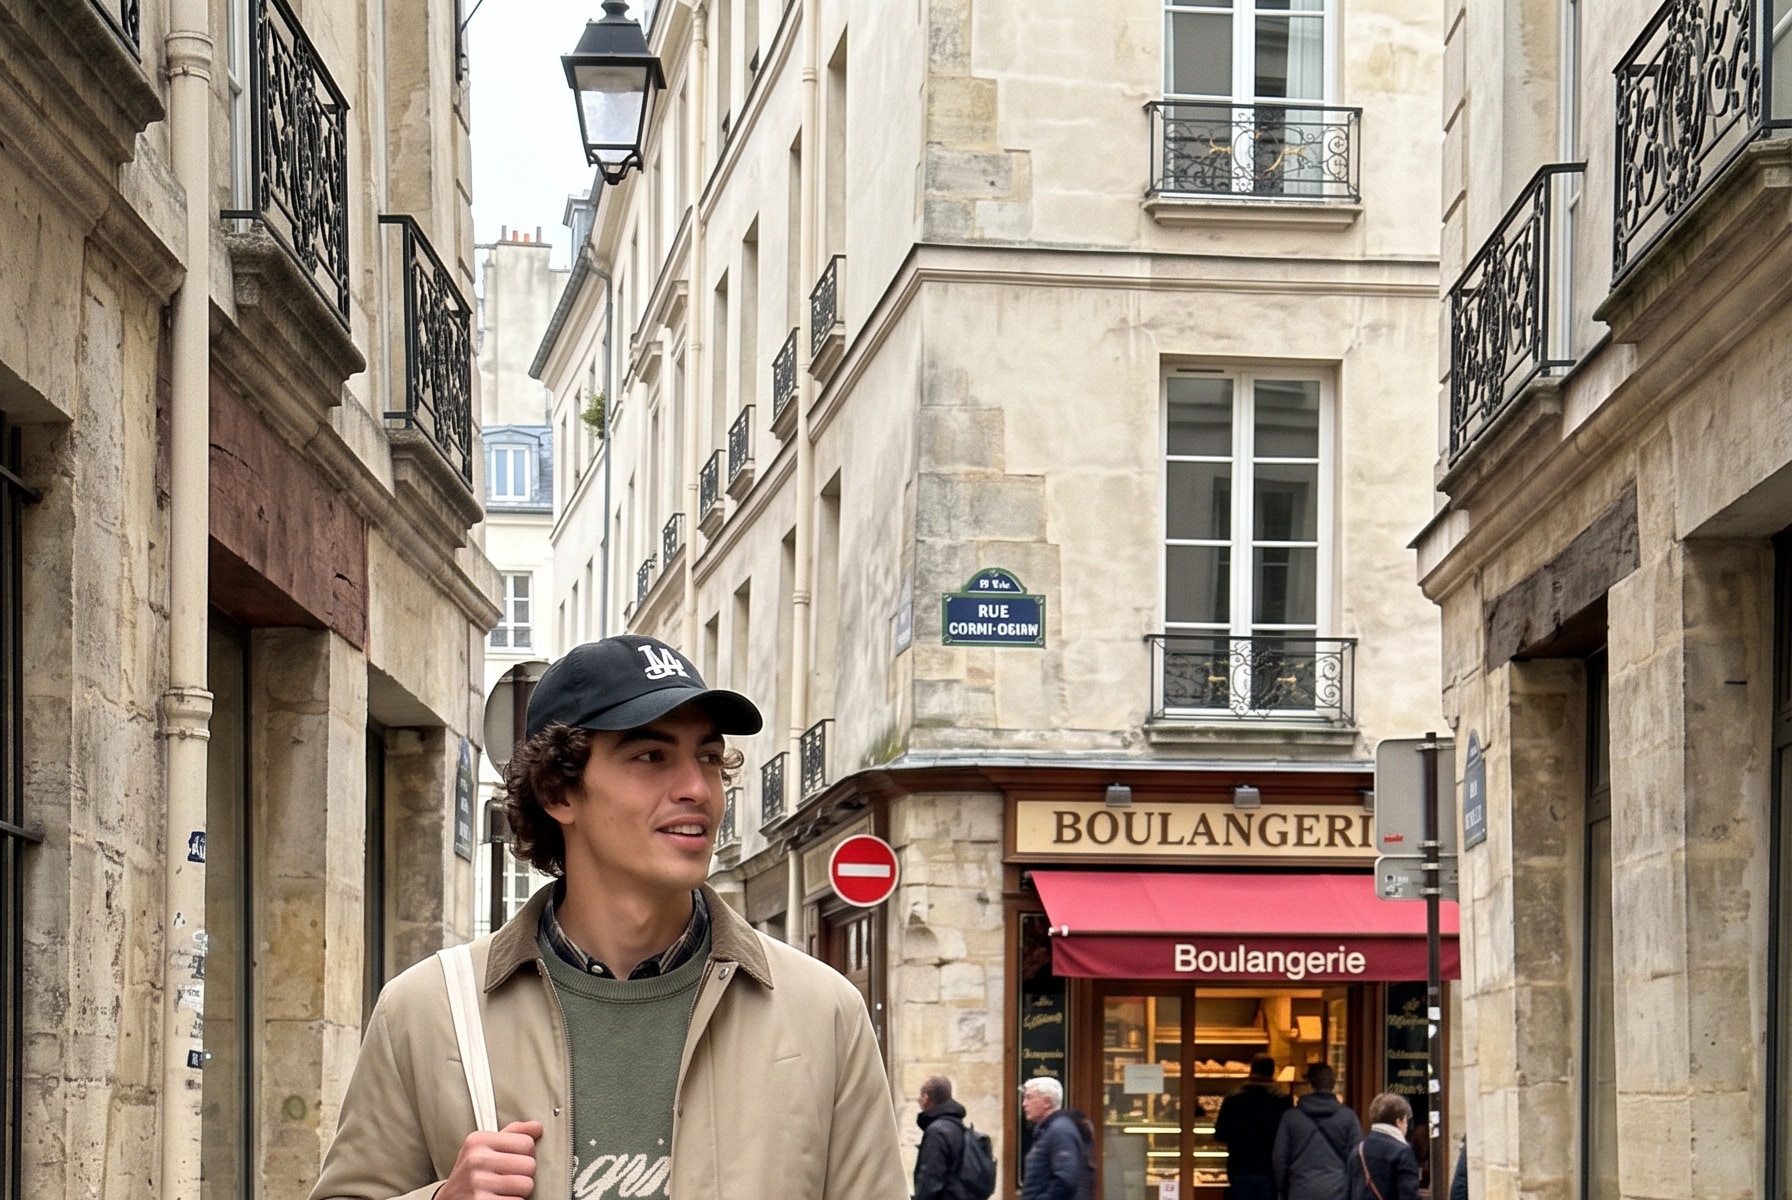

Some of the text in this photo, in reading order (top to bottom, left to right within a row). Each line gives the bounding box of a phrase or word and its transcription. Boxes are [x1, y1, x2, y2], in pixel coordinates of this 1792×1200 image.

[978, 604, 1010, 618] RUE
[637, 644, 691, 680] LA
[1052, 810, 1374, 848] BOULANGERI
[1174, 944, 1366, 980] Boulangerie
